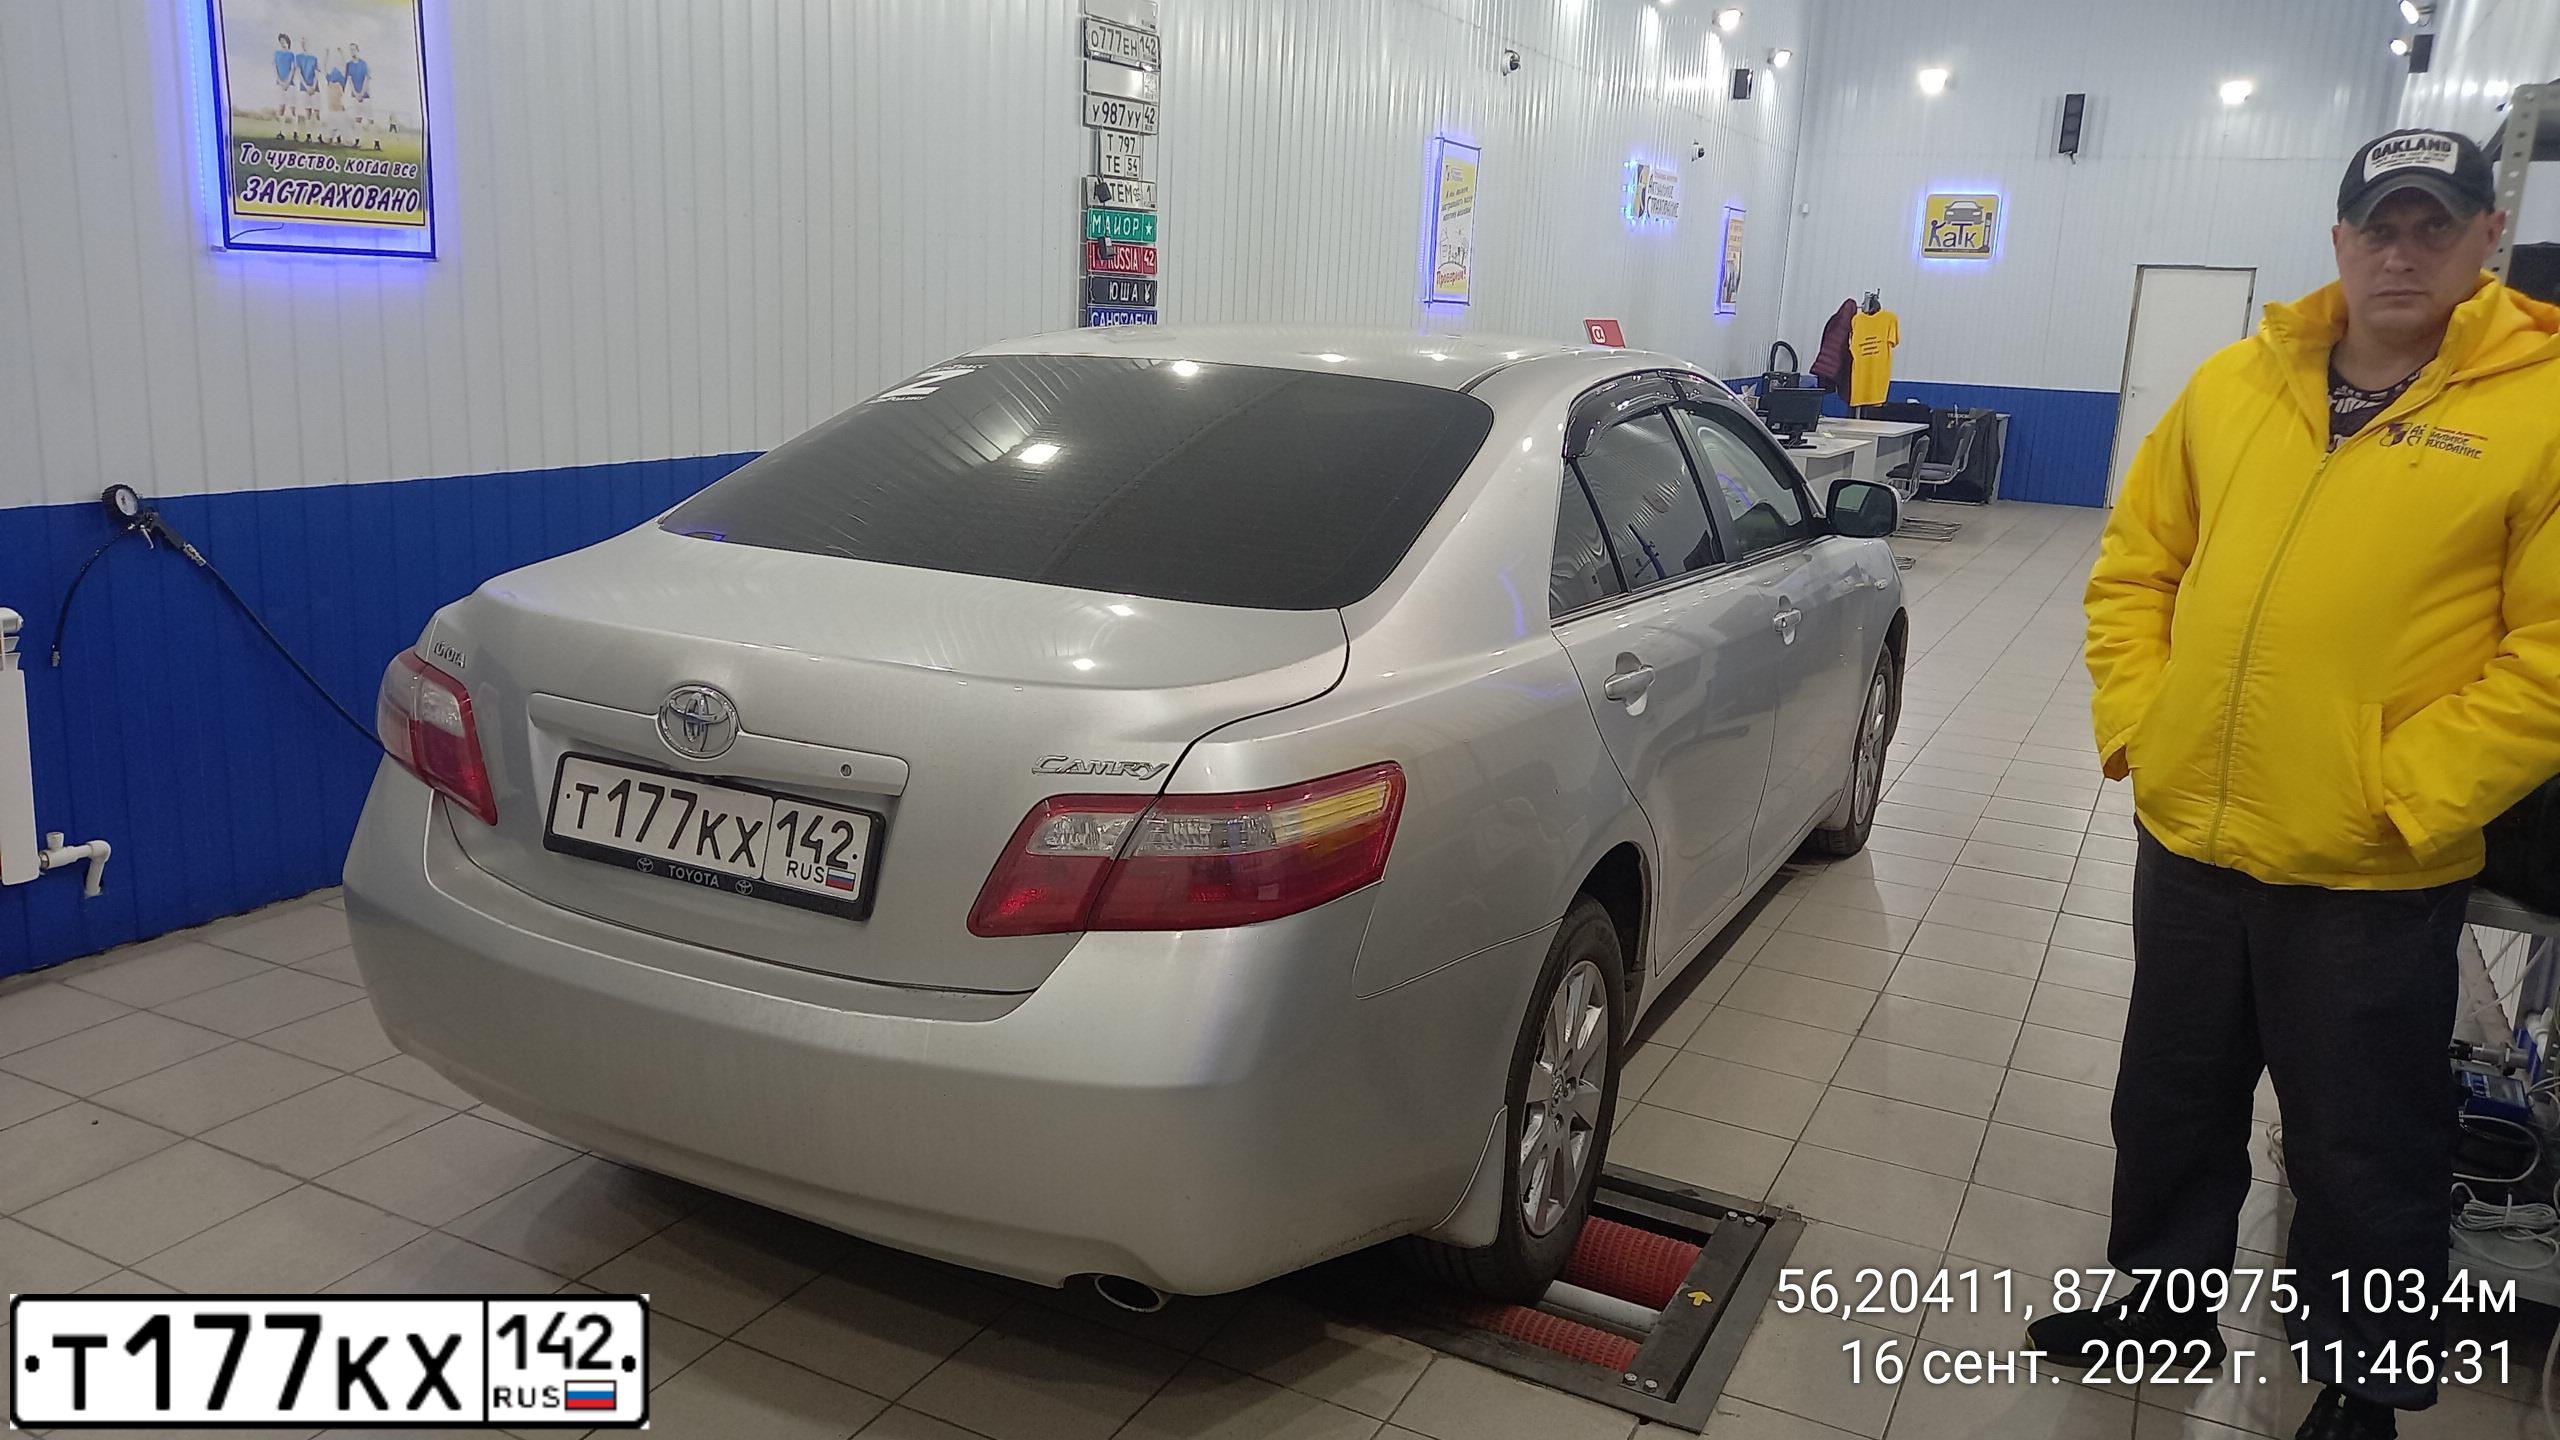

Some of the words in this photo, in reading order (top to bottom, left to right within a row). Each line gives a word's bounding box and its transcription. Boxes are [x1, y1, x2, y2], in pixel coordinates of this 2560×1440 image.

[1139, 35, 1157, 56] 142
[1092, 101, 1142, 129] У987УУ
[1144, 106, 1155, 124] 42
[1107, 133, 1114, 151] Т
[1118, 135, 1136, 154] 797
[240, 144, 260, 163] То
[344, 158, 389, 175] когда
[393, 164, 417, 177] все
[1106, 154, 1120, 173] ТЕ
[1127, 157, 1138, 172] 54
[243, 178, 419, 212] ЗАСТРАХОВАНО
[1144, 249, 1155, 267] 42
[575, 778, 764, 868] Т177КХ
[776, 810, 854, 870] 142
[667, 864, 720, 888] TOYOTA
[786, 860, 826, 884] RUS
